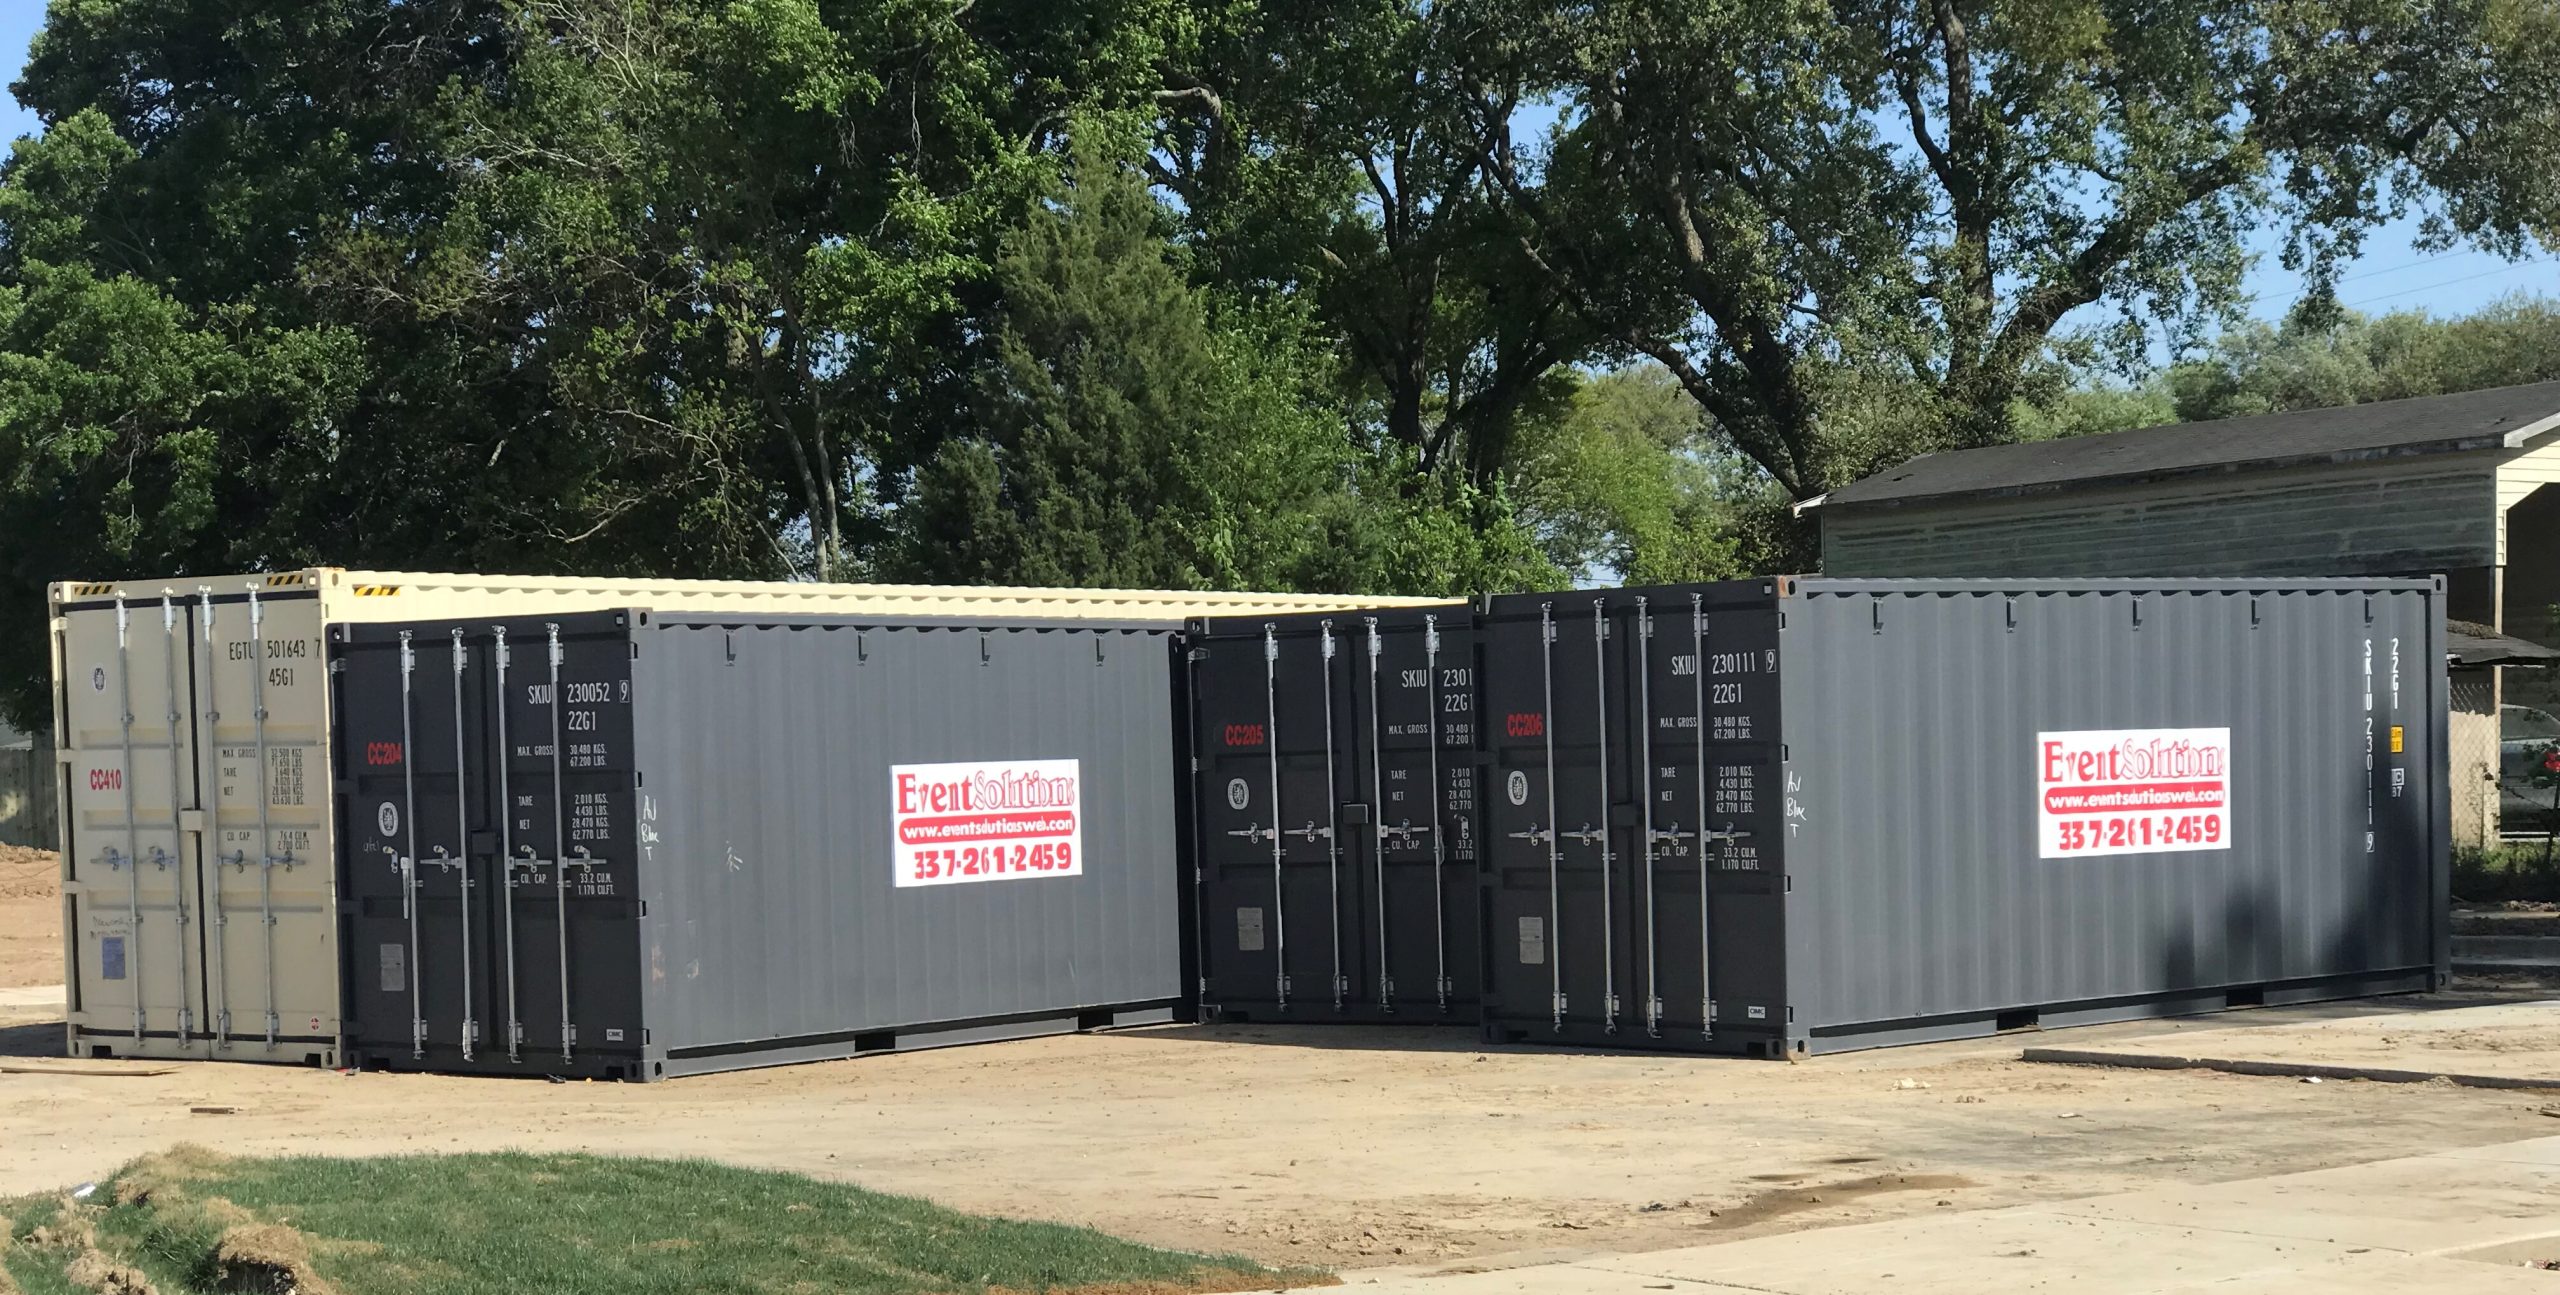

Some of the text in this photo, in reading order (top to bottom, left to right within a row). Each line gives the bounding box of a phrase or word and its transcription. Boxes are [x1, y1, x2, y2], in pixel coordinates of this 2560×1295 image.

[267, 640, 306, 659] 501643
[315, 638, 321, 657] 7
[1671, 650, 1775, 675] SKIU 230111 9
[269, 668, 294, 687] 45G1
[1401, 669, 1427, 688] SKIU
[2365, 639, 2373, 711] SKIU
[528, 681, 628, 705] SKIU 230052 9
[1444, 693, 1474, 712] 22G1
[1713, 683, 1742, 704] 22G1
[568, 711, 596, 731] 22G1
[1407, 723, 1428, 734] GROSS
[1507, 713, 1543, 737] CC206
[1677, 716, 1698, 728] GROSS
[1225, 724, 1264, 746] CC205
[367, 742, 402, 765] CC204
[534, 745, 554, 756] GROSS
[90, 768, 122, 791] CC410
[1390, 769, 1407, 780] TARE
[1661, 766, 1676, 778] TARE
[518, 795, 533, 807] TARE
[1392, 791, 1404, 801] NET
[1661, 790, 1673, 801] NET
[519, 819, 530, 830] NET
[1790, 823, 1799, 838] T
[2366, 832, 2374, 852] 9
[645, 846, 653, 861] T
[1723, 847, 1739, 858] 33.2
